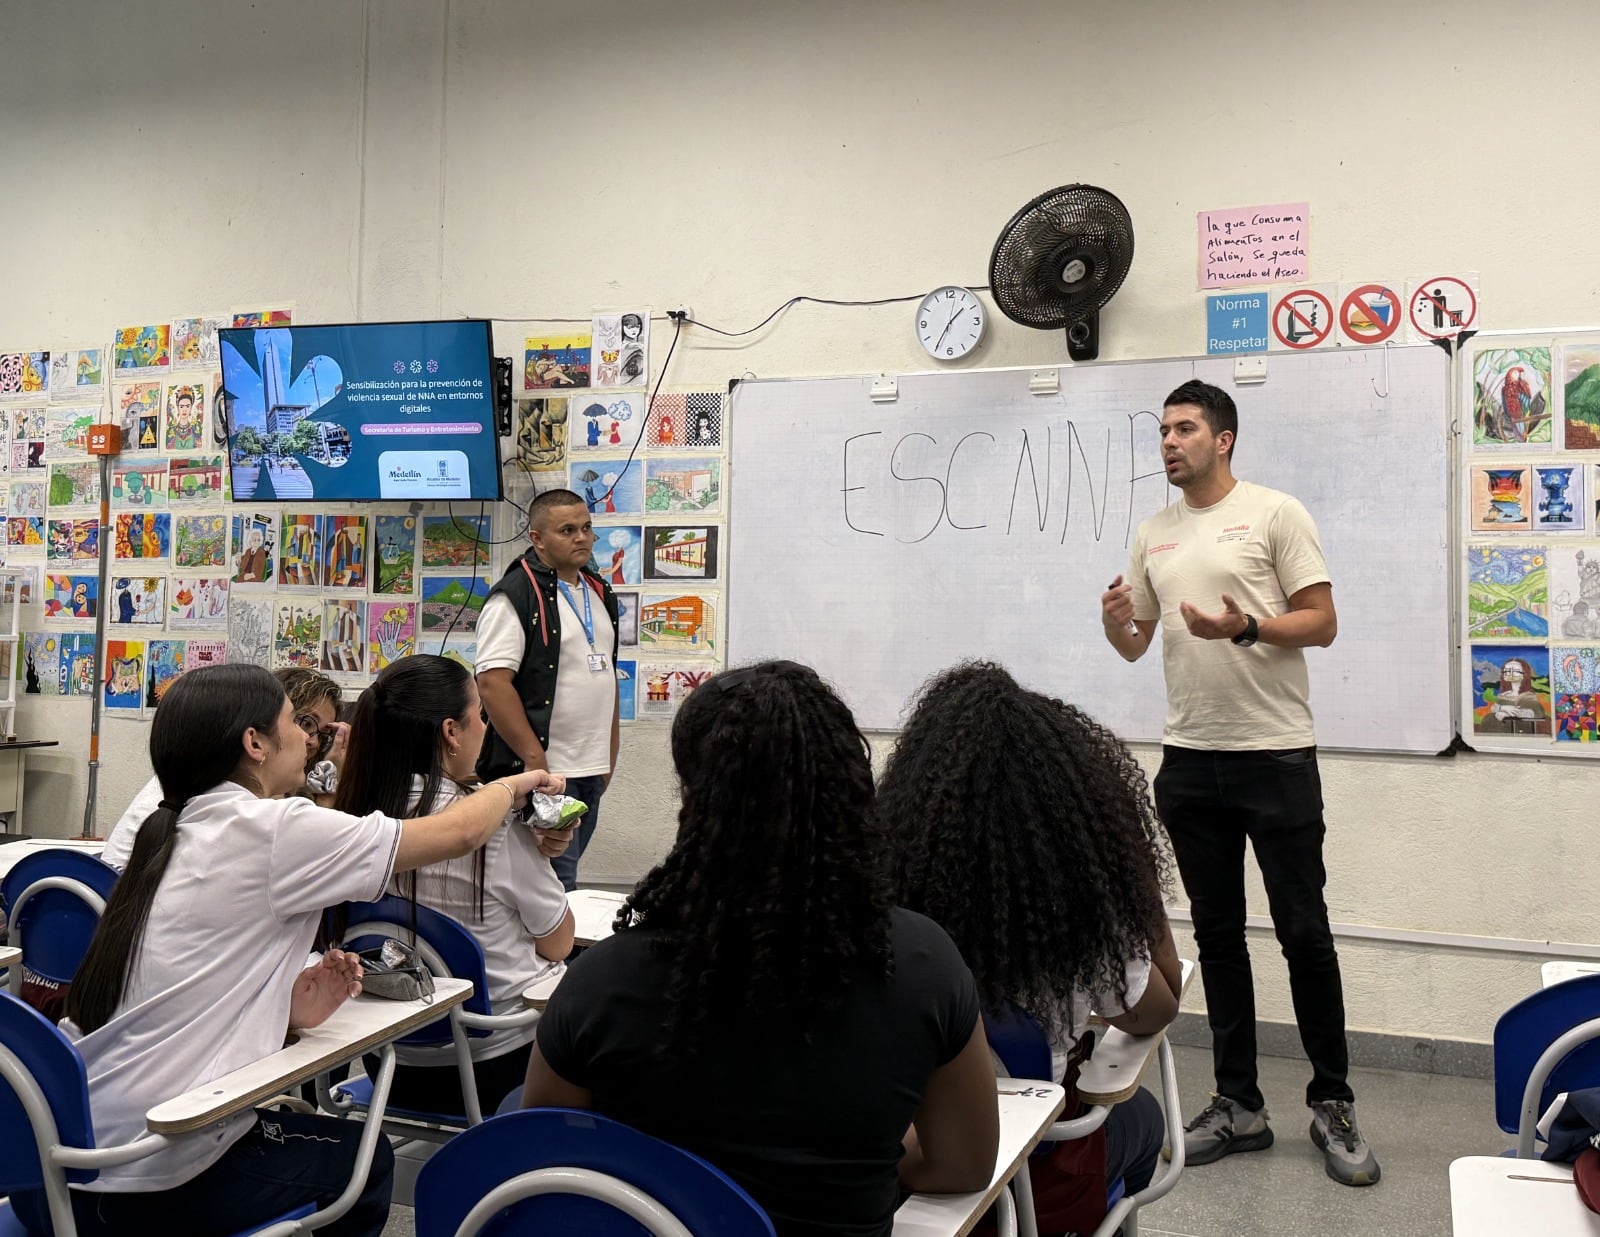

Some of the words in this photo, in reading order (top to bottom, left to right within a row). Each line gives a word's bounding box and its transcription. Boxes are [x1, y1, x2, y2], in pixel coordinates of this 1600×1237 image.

[1225, 219, 1247, 235] que
[1289, 230, 1300, 243] el
[1267, 247, 1306, 264] queda
[1206, 268, 1258, 281] haciendo
[1261, 269, 1271, 279] el
[945, 290, 956, 299] 12
[1216, 298, 1260, 312] Norma
[920, 320, 928, 329] 9
[973, 317, 981, 326] 3
[1231, 317, 1247, 329] #1
[1209, 335, 1267, 351] Respetar
[946, 347, 954, 356] 6
[346, 380, 400, 390] Sensibilización
[401, 381, 419, 390] para
[419, 379, 427, 388] la
[428, 378, 471, 390] prevención
[472, 379, 483, 387] de
[347, 392, 380, 402] violencia
[381, 392, 405, 401] sexual
[406, 392, 417, 401] de
[418, 392, 436, 400] NNA
[449, 391, 484, 400] entornos
[399, 404, 432, 415] digitales
[430, 425, 479, 433] Entretenimiento
[388, 469, 422, 479] Medellín
